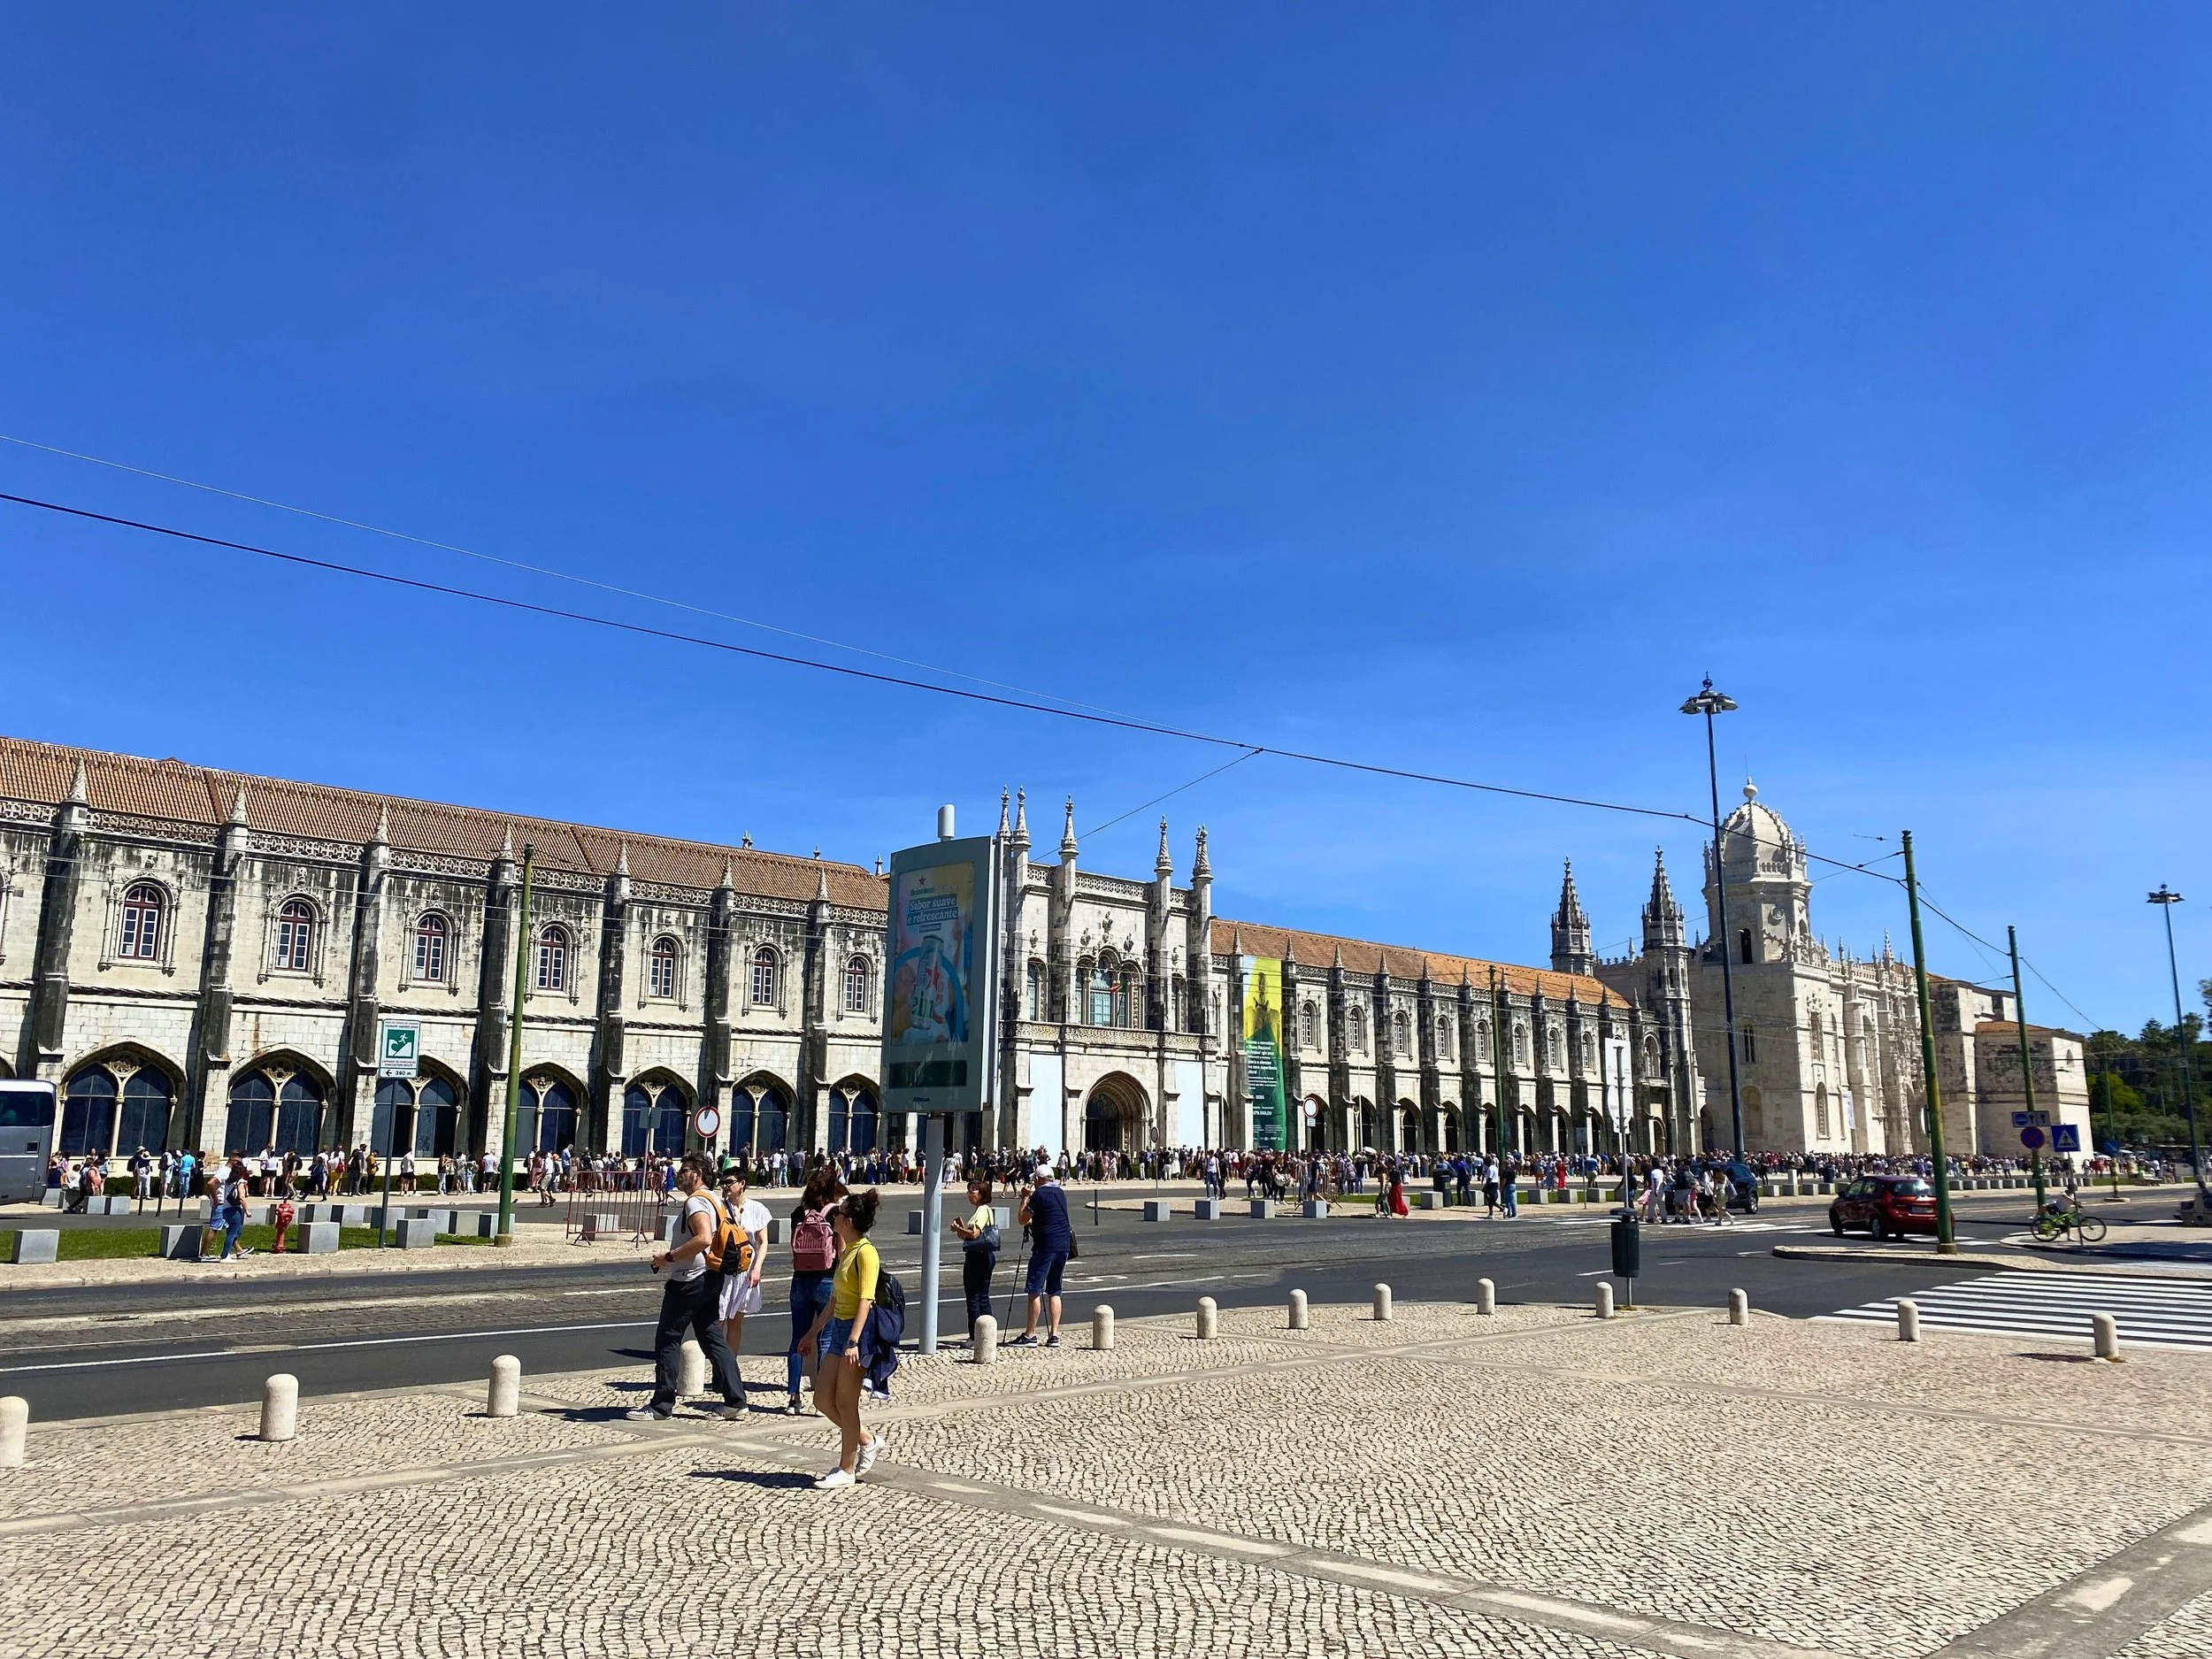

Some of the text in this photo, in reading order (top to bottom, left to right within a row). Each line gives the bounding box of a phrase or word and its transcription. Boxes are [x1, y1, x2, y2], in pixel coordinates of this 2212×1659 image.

[910, 897, 956, 910] Sabor suave
[912, 910, 957, 923] refrescante
